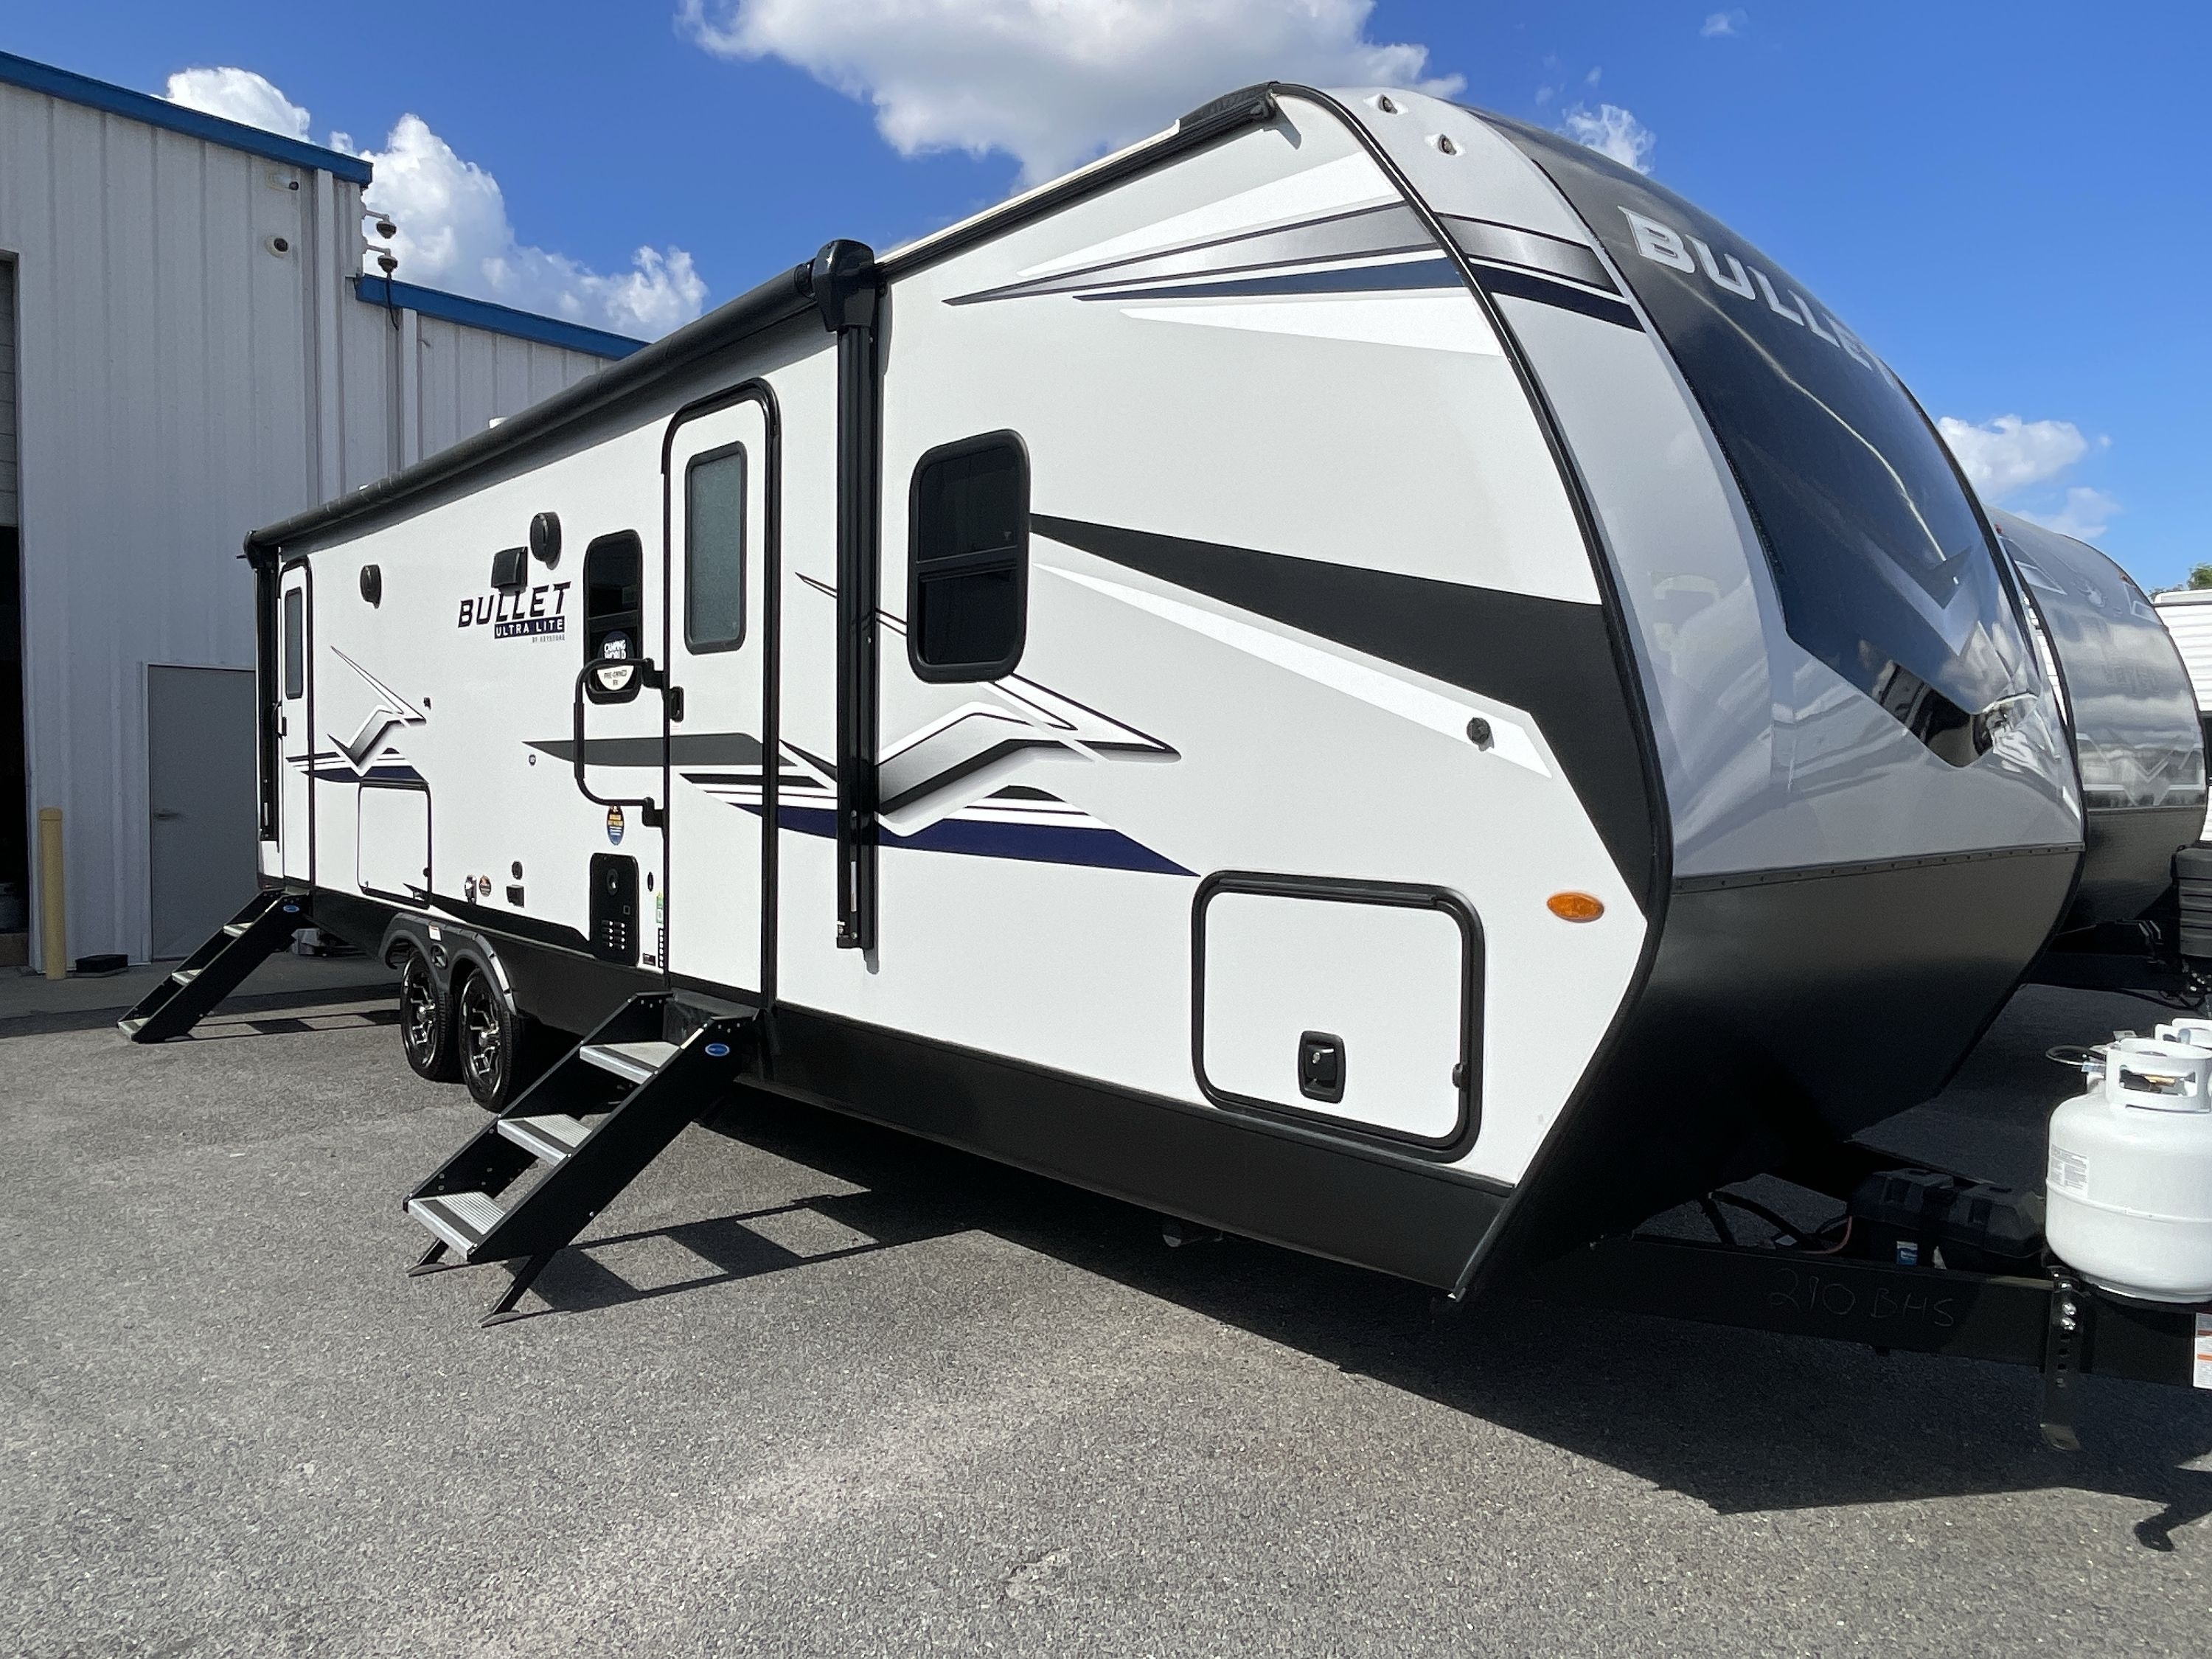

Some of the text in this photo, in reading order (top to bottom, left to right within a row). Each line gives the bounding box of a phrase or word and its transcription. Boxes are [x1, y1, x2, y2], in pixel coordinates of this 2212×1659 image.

[458, 581, 571, 627] BULLET
[495, 619, 563, 636] ULTRA LITE
[1870, 1287, 1954, 1326] BHS
